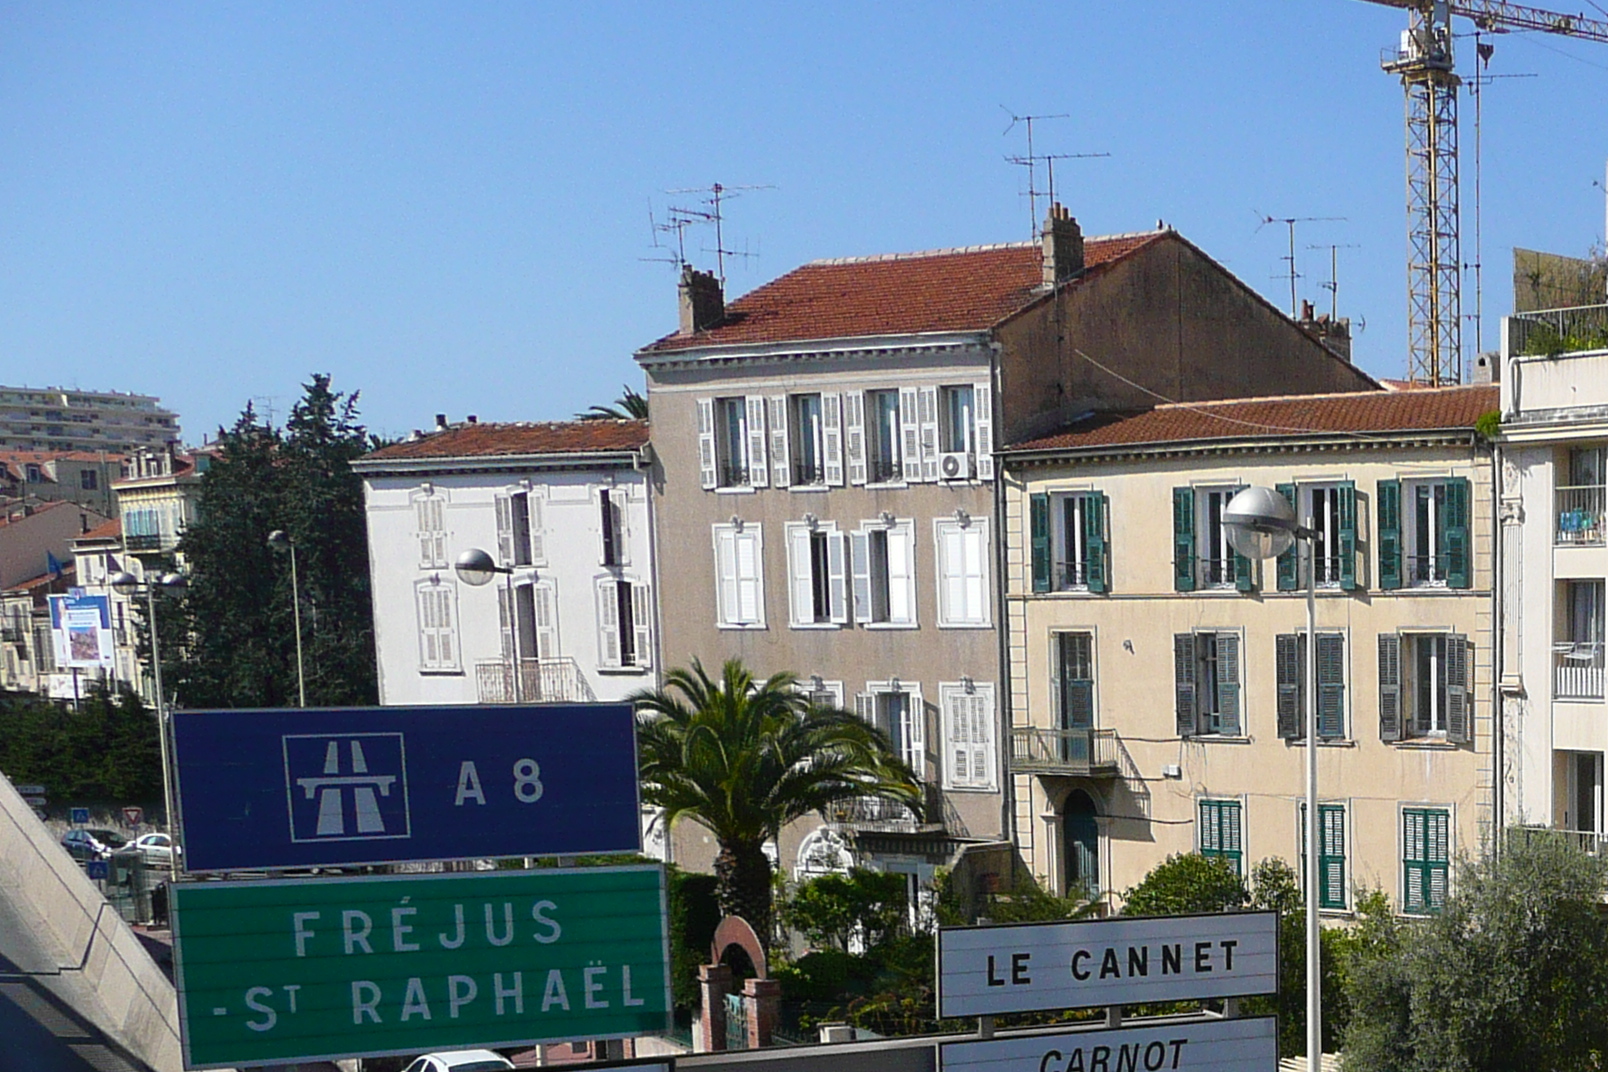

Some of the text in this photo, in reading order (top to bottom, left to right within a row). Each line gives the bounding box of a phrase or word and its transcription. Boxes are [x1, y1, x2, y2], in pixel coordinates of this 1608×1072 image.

[454, 758, 544, 807] A 8
[293, 897, 562, 957] FRÉJUS
[986, 940, 1238, 987] LE CANNET
[351, 960, 645, 1025] RAPHAËL
